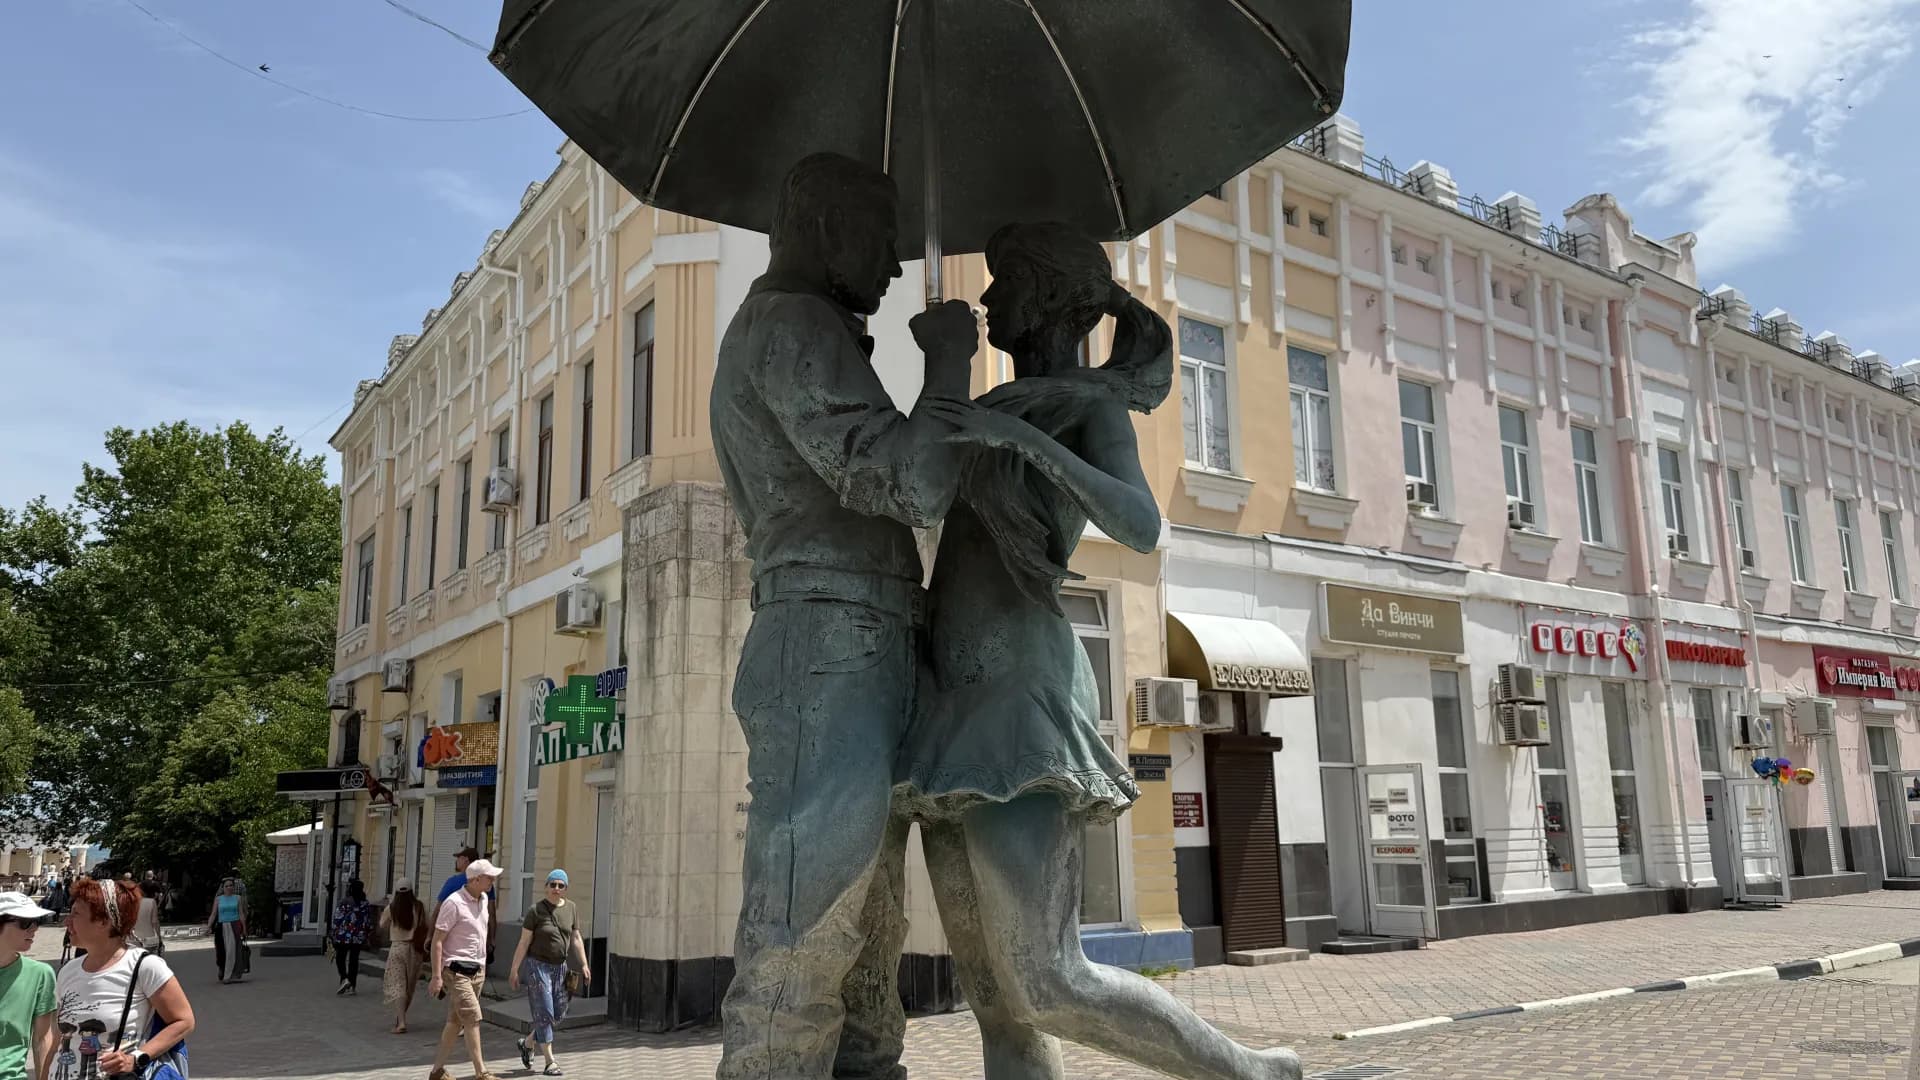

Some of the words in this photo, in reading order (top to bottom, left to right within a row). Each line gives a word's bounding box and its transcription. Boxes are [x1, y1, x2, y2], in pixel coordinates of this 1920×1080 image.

[1360, 598, 1384, 628] Да
[1389, 602, 1434, 629] Винчи
[1665, 640, 1746, 667] ШКОЛЯРИК
[1837, 667, 1878, 690] Империя
[1388, 814, 1415, 822] ФОТО
